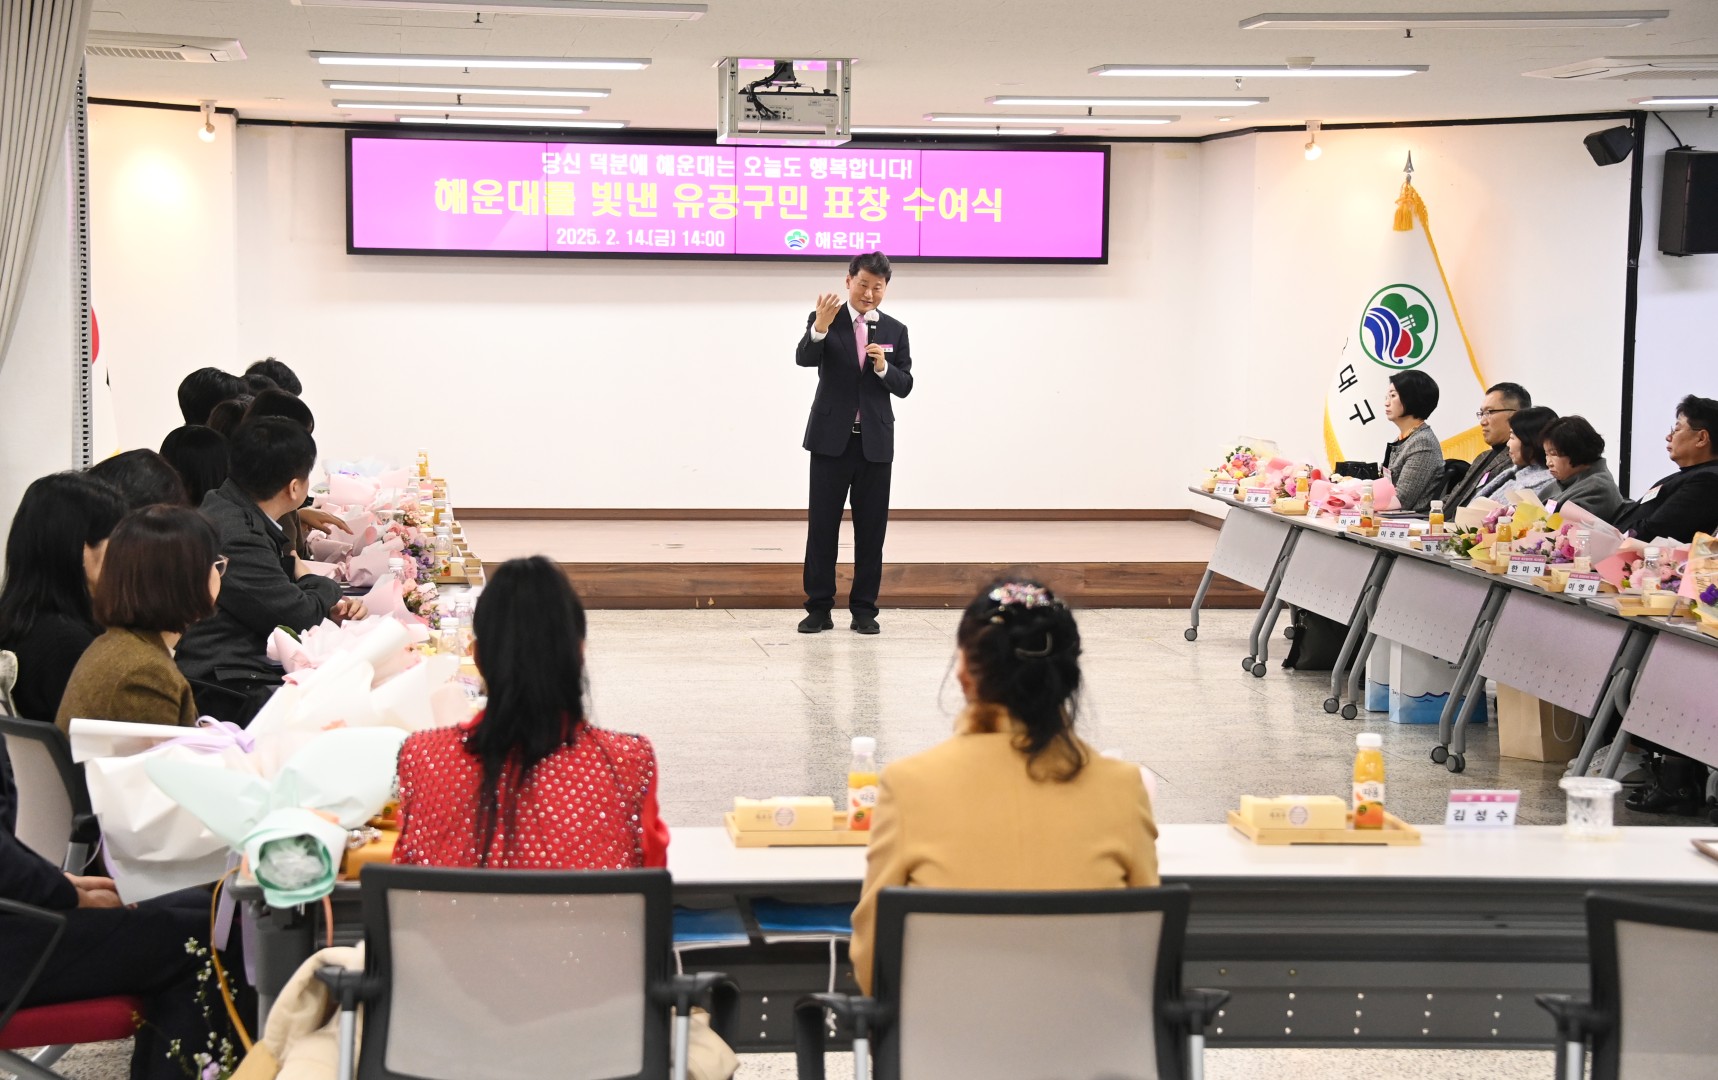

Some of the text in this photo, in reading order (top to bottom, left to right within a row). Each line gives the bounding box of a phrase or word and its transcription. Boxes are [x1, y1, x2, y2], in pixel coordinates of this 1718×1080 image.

[542, 151, 913, 180] 당신 덕분에 해운대는 오늘도 행복합니다!
[434, 177, 1003, 223] 해운대를 빛낸 유공구민 표창 수여식
[556, 227, 601, 246] 2025.
[605, 228, 620, 246] 2.
[682, 230, 725, 248] 14:00
[815, 231, 881, 250] 해운대구
[1453, 808, 1508, 822] 김성수
